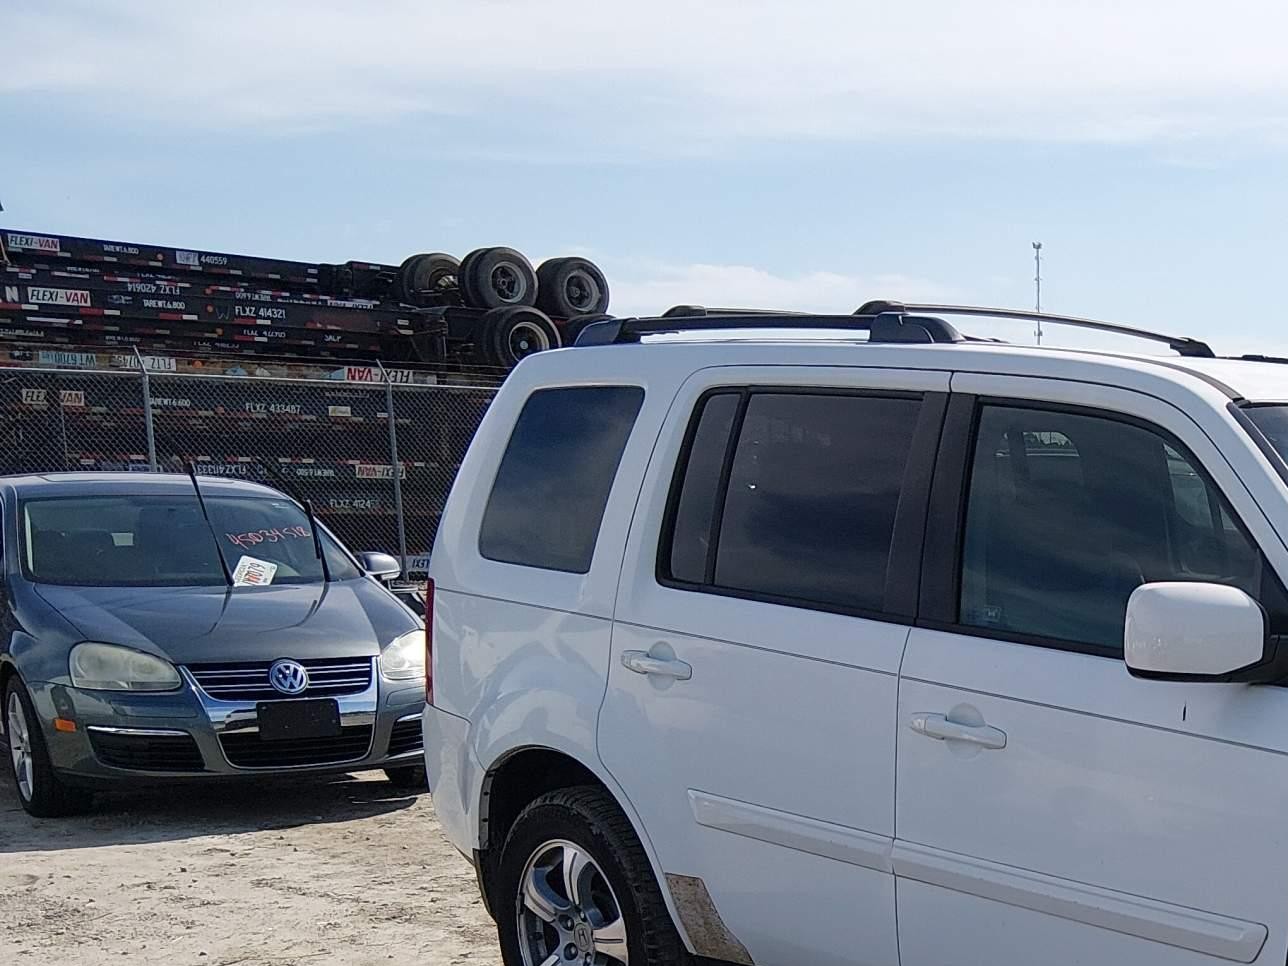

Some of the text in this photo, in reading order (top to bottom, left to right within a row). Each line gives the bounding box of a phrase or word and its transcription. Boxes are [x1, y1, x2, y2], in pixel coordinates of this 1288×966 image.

[9, 235, 58, 250] FLEXI-VAN
[30, 289, 89, 305] FLEXI-VAN
[235, 306, 286, 319] FLXZ 414321
